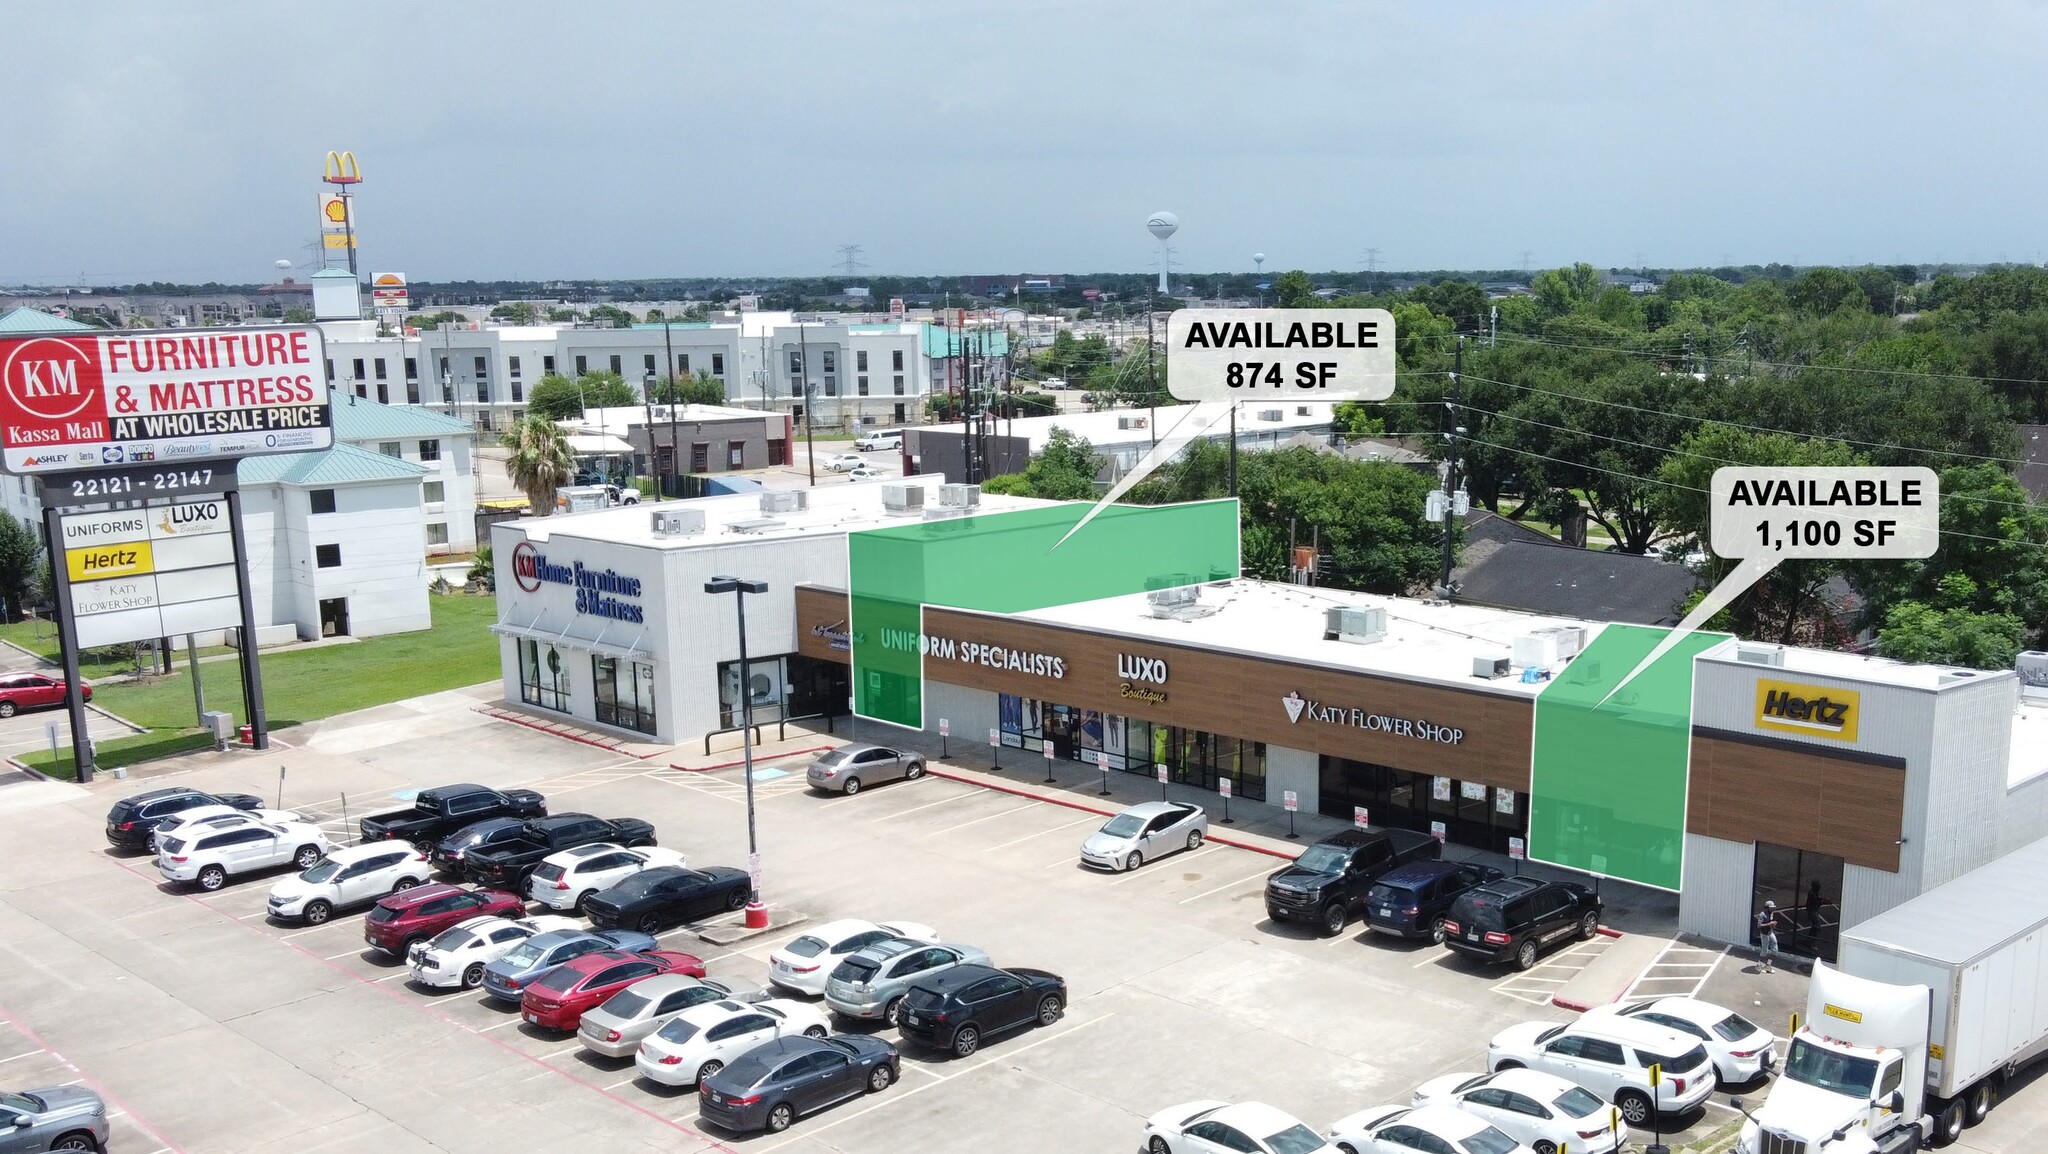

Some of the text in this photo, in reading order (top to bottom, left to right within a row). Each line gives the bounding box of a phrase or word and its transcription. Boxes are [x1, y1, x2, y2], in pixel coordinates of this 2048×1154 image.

[107, 331, 310, 373] FURNITURE
[20, 359, 81, 397] KM
[114, 374, 314, 413] & MATTRESS
[9, 421, 104, 444] Kassa Mall
[115, 406, 322, 439] AT WHOLESALE PRICE
[36, 453, 69, 464] ASHLEY
[79, 451, 95, 461] Serta
[163, 441, 212, 456] Beautyrest
[72, 475, 131, 497] 22121
[154, 469, 213, 490] 22147
[172, 502, 218, 524] LUXO
[67, 519, 144, 538] UNIFORMS
[179, 523, 214, 534] Boutique
[84, 550, 137, 570] Hertz
[517, 553, 642, 597] KM Home Furniture
[110, 583, 137, 596] KATY
[79, 595, 153, 614] FLOWER SHOP
[587, 588, 644, 625] Mattress
[880, 627, 956, 660] UNIFORM
[960, 641, 1064, 680] SPECIALISTS
[1118, 653, 1167, 684] LUXO
[1120, 682, 1166, 706] Boutique
[1763, 689, 1849, 725] Hertz
[1307, 700, 1463, 745] KATY FLOWER SHOP
